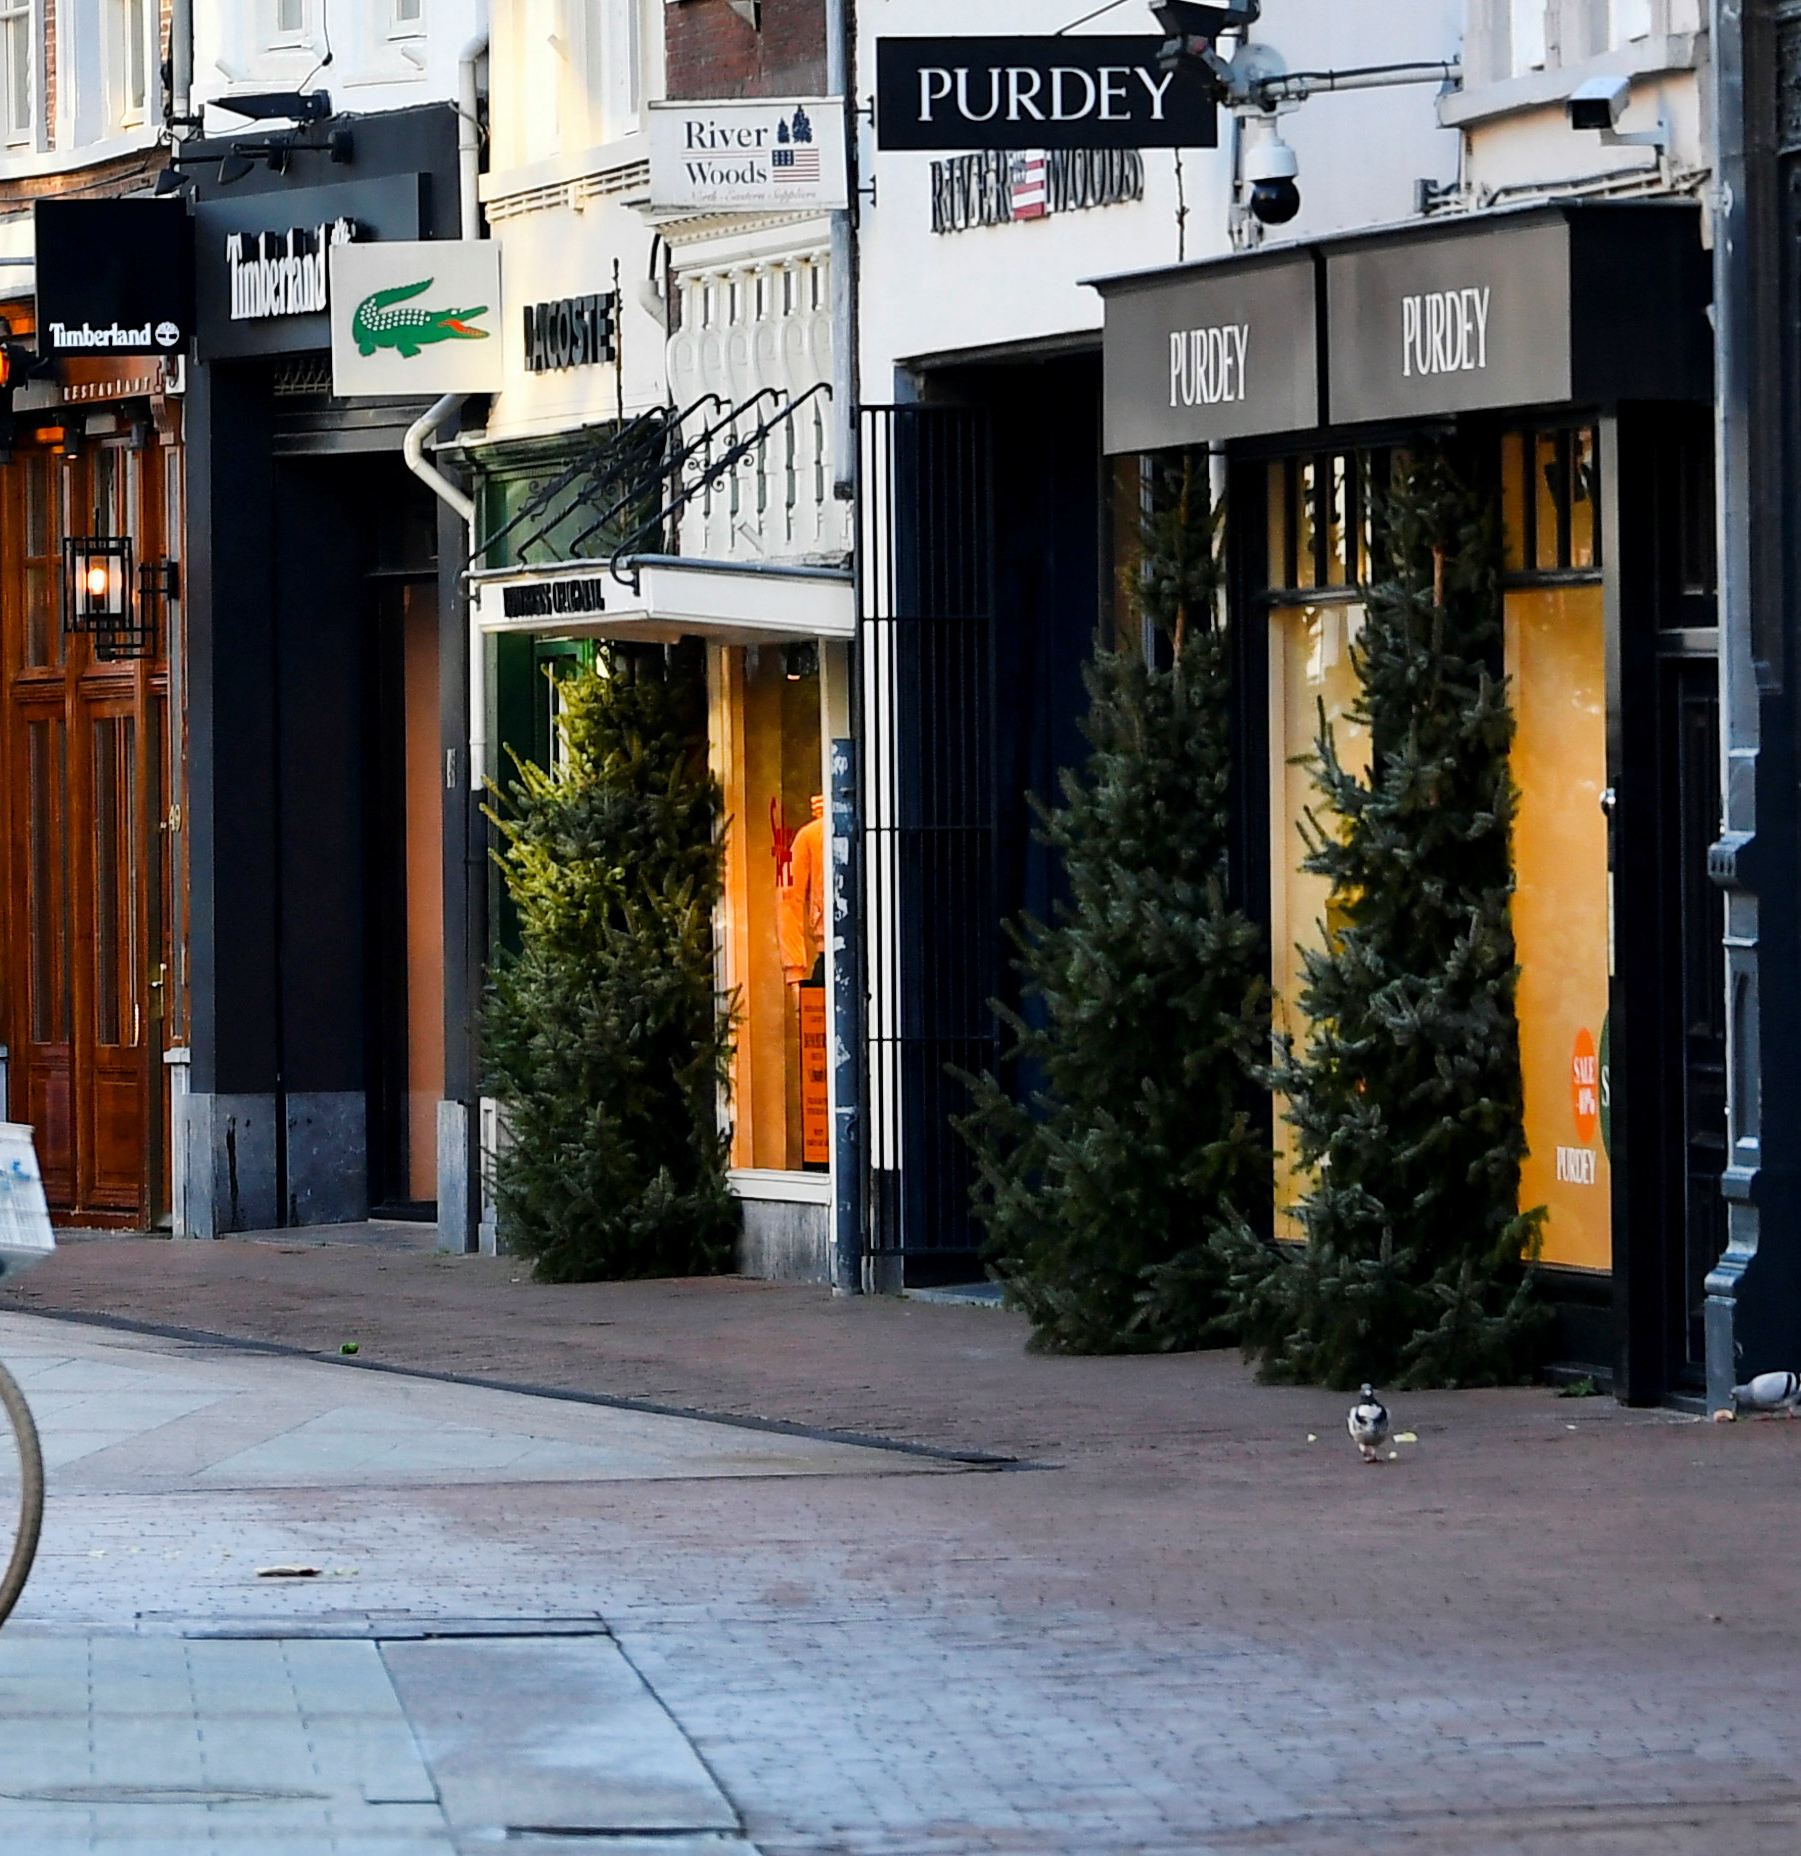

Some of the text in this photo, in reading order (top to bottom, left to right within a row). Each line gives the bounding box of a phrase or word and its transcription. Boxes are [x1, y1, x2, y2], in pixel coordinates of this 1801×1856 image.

[916, 66, 1175, 122] PURDEY
[684, 120, 769, 150] River
[685, 159, 768, 186] Woods
[226, 222, 327, 321] Timberland
[49, 321, 152, 348] Timberland
[523, 292, 616, 372] LACOSTE
[1169, 323, 1250, 408] PURDEY
[1401, 285, 1491, 378] PURDEY
